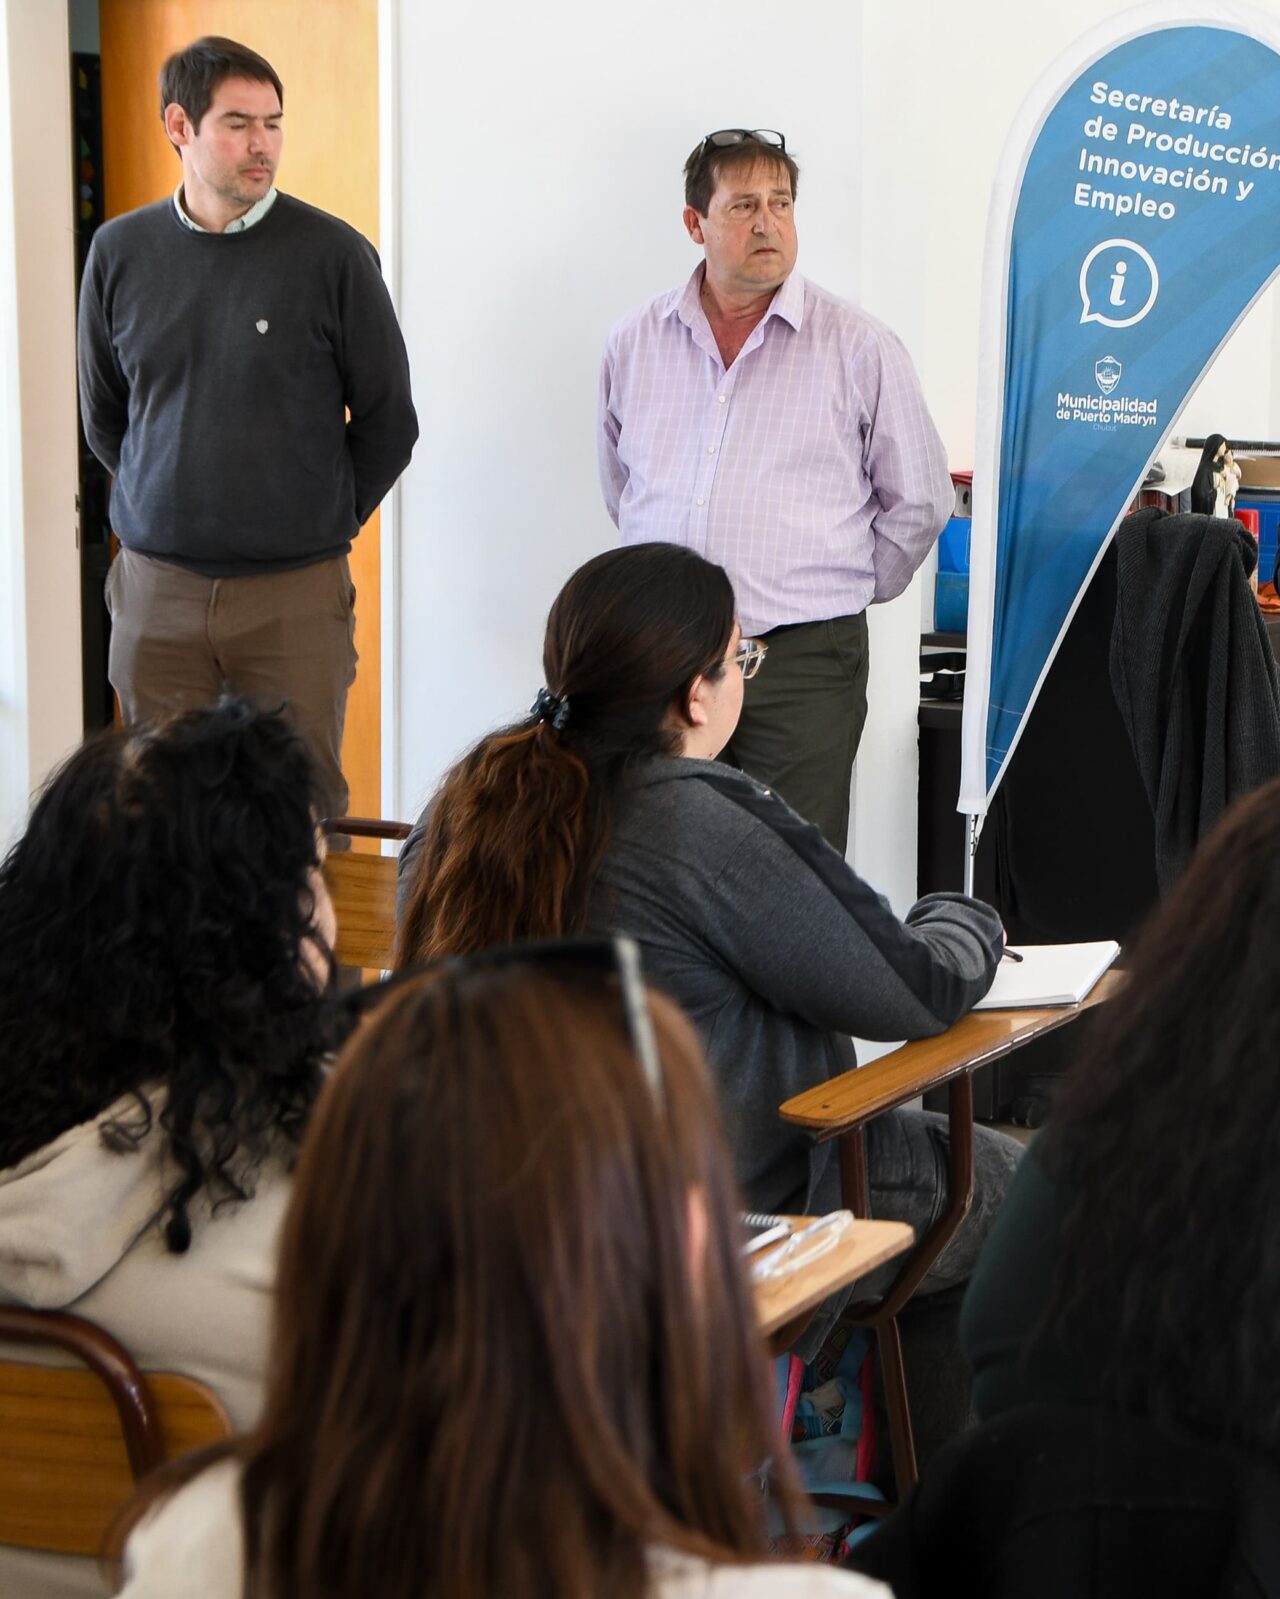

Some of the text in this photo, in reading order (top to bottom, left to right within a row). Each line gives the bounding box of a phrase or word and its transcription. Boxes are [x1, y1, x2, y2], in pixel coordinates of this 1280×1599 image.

[1090, 81, 1232, 130] Secretaría
[1084, 116, 1118, 141] de
[1079, 149, 1254, 201] Innovación y
[1074, 183, 1175, 219] Empleo
[1056, 408, 1156, 427] de Puerto Madryn
[1057, 393, 1157, 413] Municipalidad
